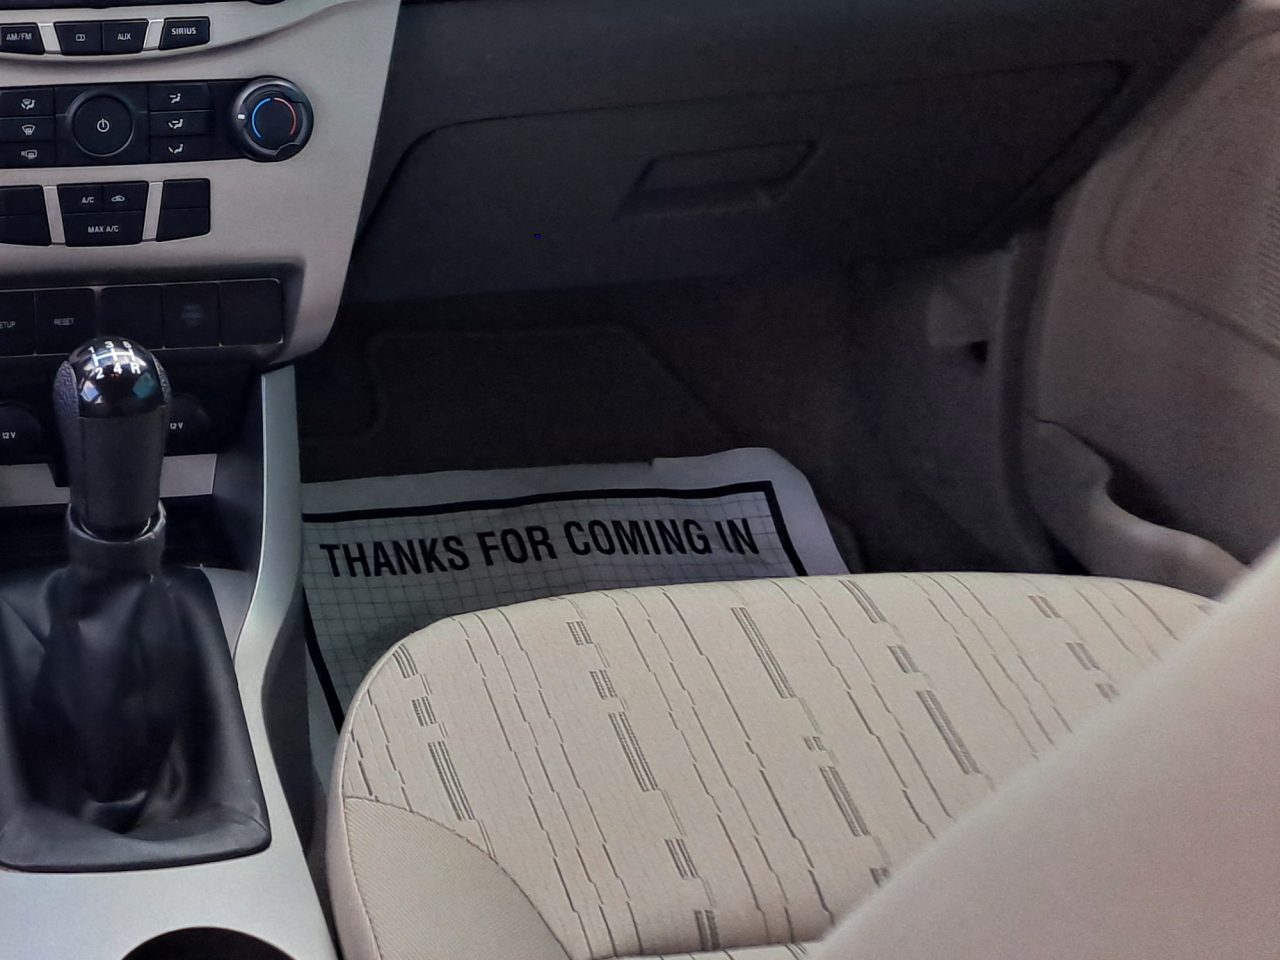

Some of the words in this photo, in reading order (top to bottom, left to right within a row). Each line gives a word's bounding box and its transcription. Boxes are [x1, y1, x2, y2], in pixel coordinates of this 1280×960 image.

[171, 27, 197, 35] SIRIUS
[6, 33, 32, 41] AM/FM
[54, 317, 74, 326] RESET
[95, 368, 104, 379] 2
[113, 363, 122, 374] 4
[130, 363, 141, 374] R
[320, 536, 469, 578] THANKS
[481, 524, 558, 566] FOR
[564, 518, 710, 557] COMING
[719, 518, 759, 555] IN
